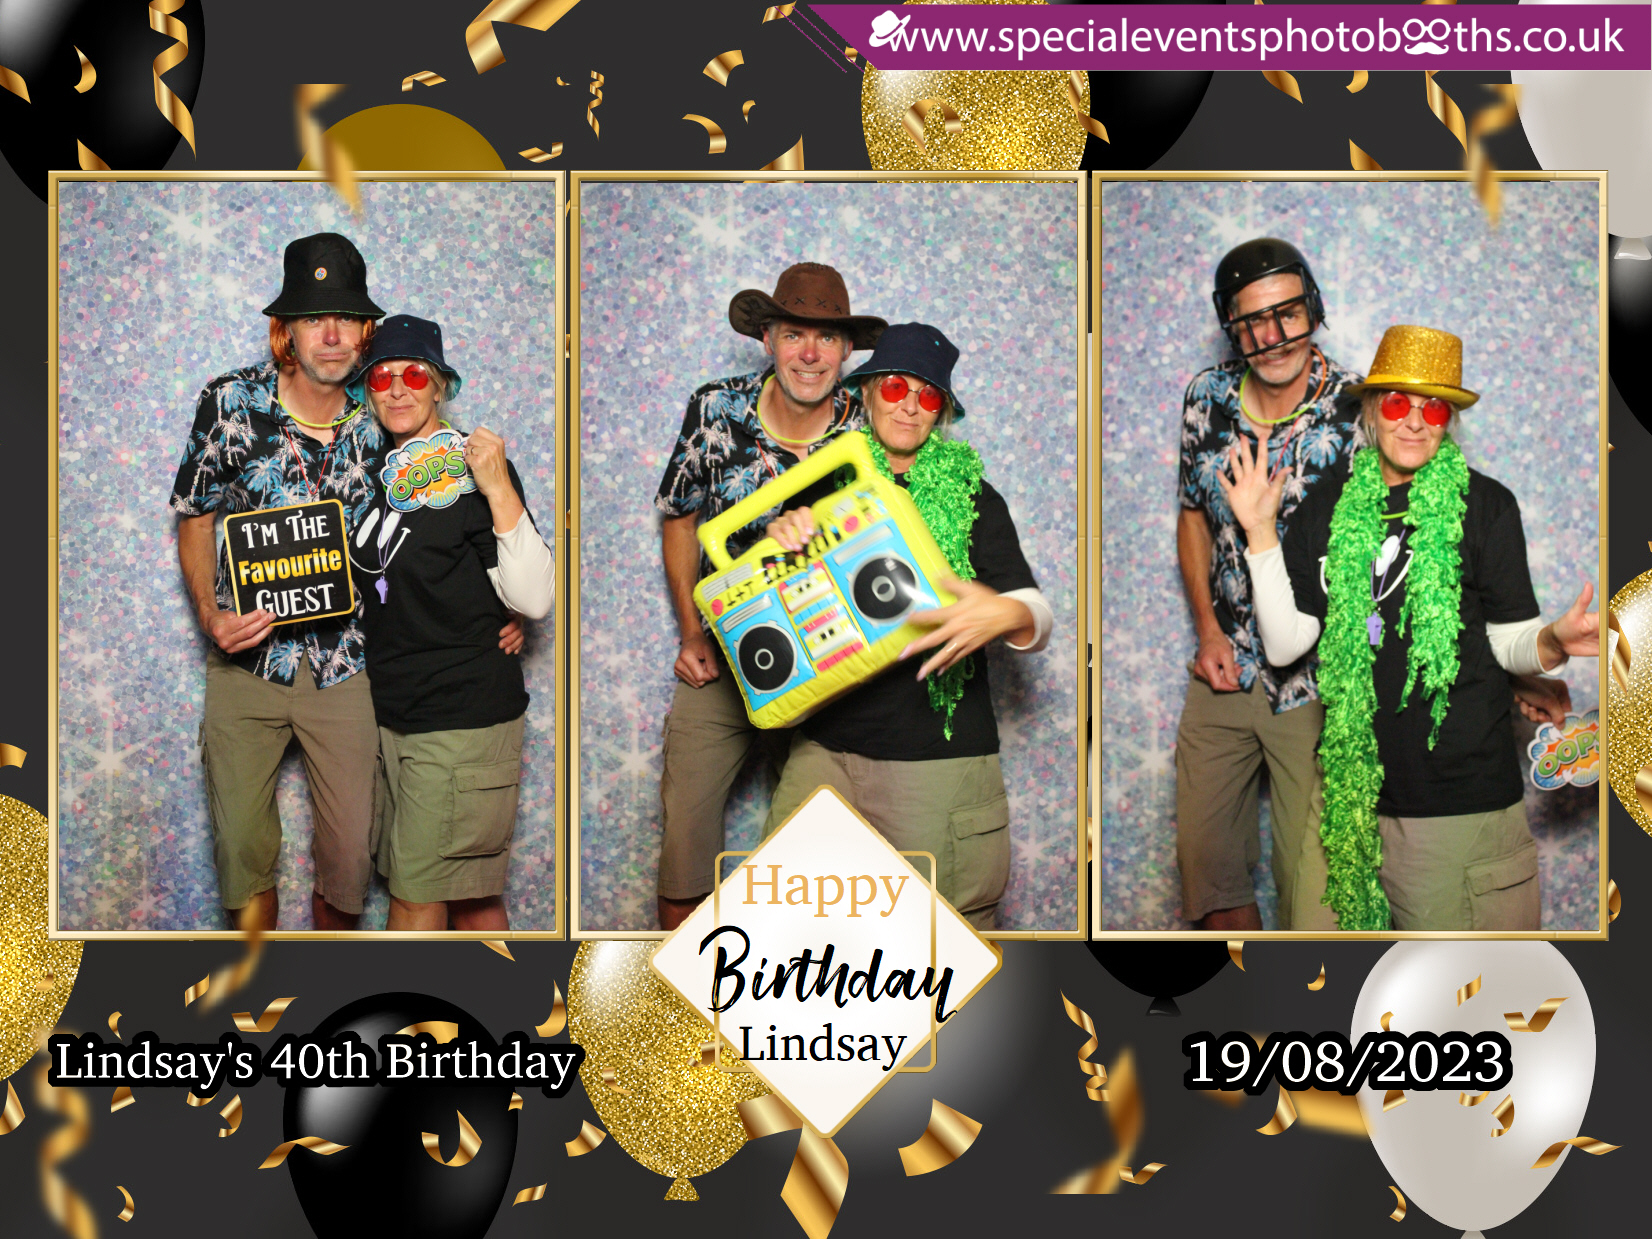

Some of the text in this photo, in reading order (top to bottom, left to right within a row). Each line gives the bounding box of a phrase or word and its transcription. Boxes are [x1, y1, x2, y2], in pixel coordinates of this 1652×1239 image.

[390, 450, 467, 501] OOPS
[241, 510, 331, 549] I'M THE
[237, 547, 342, 586] Favourite
[255, 583, 335, 617] GUEST
[1538, 730, 1599, 778] OOP
